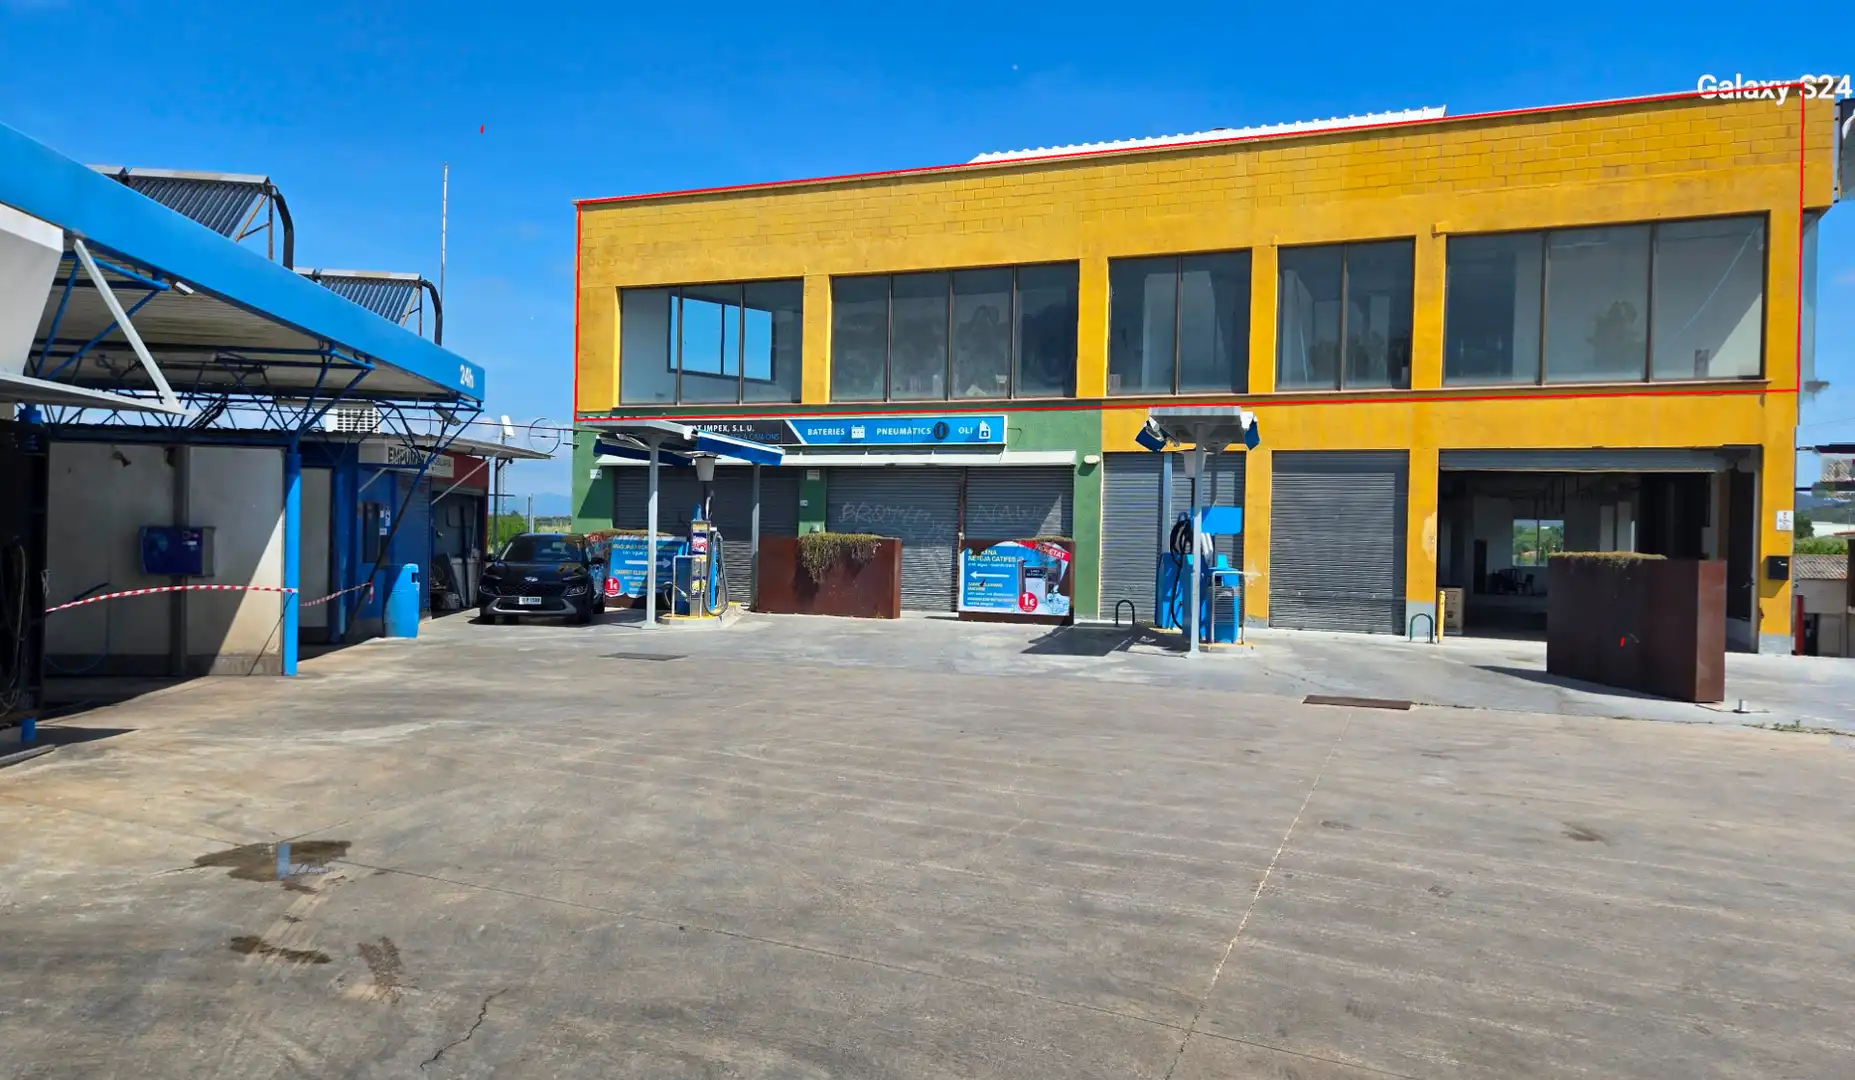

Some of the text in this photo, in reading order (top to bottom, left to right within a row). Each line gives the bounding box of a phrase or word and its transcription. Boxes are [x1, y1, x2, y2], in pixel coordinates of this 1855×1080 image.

[460, 364, 474, 389] 24h
[732, 424, 755, 432] S.L.U.
[807, 428, 845, 436] BATERIES
[958, 426, 973, 434] OLI
[1022, 594, 1035, 606] 1€
